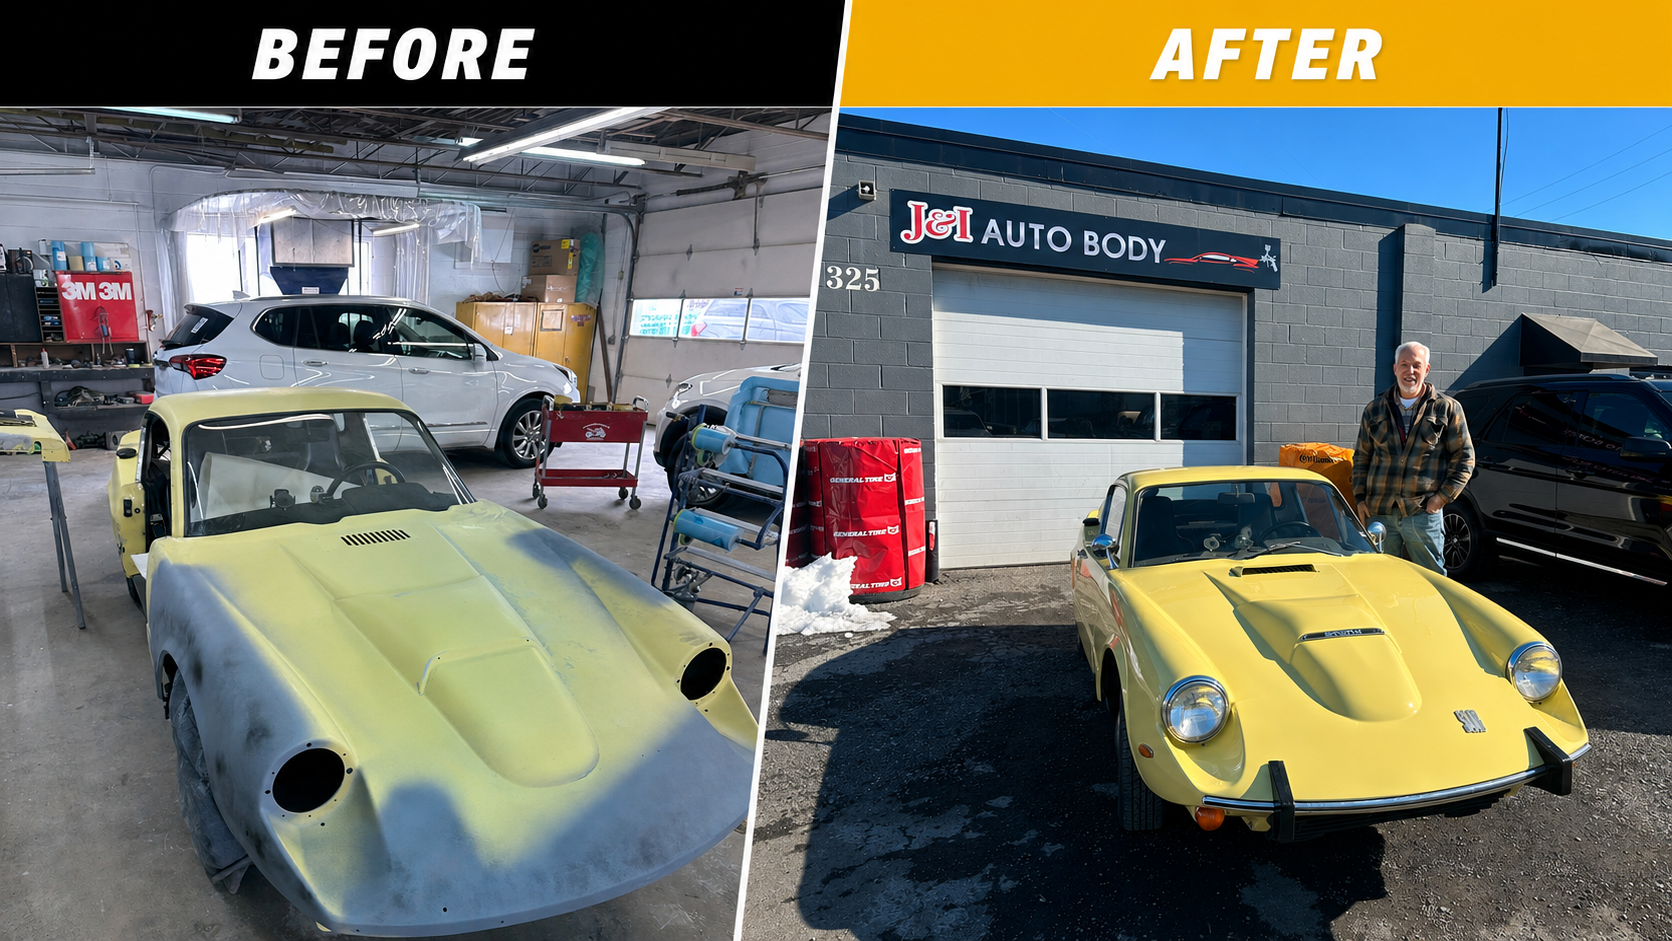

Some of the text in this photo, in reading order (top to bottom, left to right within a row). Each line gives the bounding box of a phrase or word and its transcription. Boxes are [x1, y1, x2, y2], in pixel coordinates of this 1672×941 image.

[900, 200, 1166, 263] J&I AUTO BODY
[61, 281, 133, 301] 3M 3M
[826, 265, 880, 292] 325
